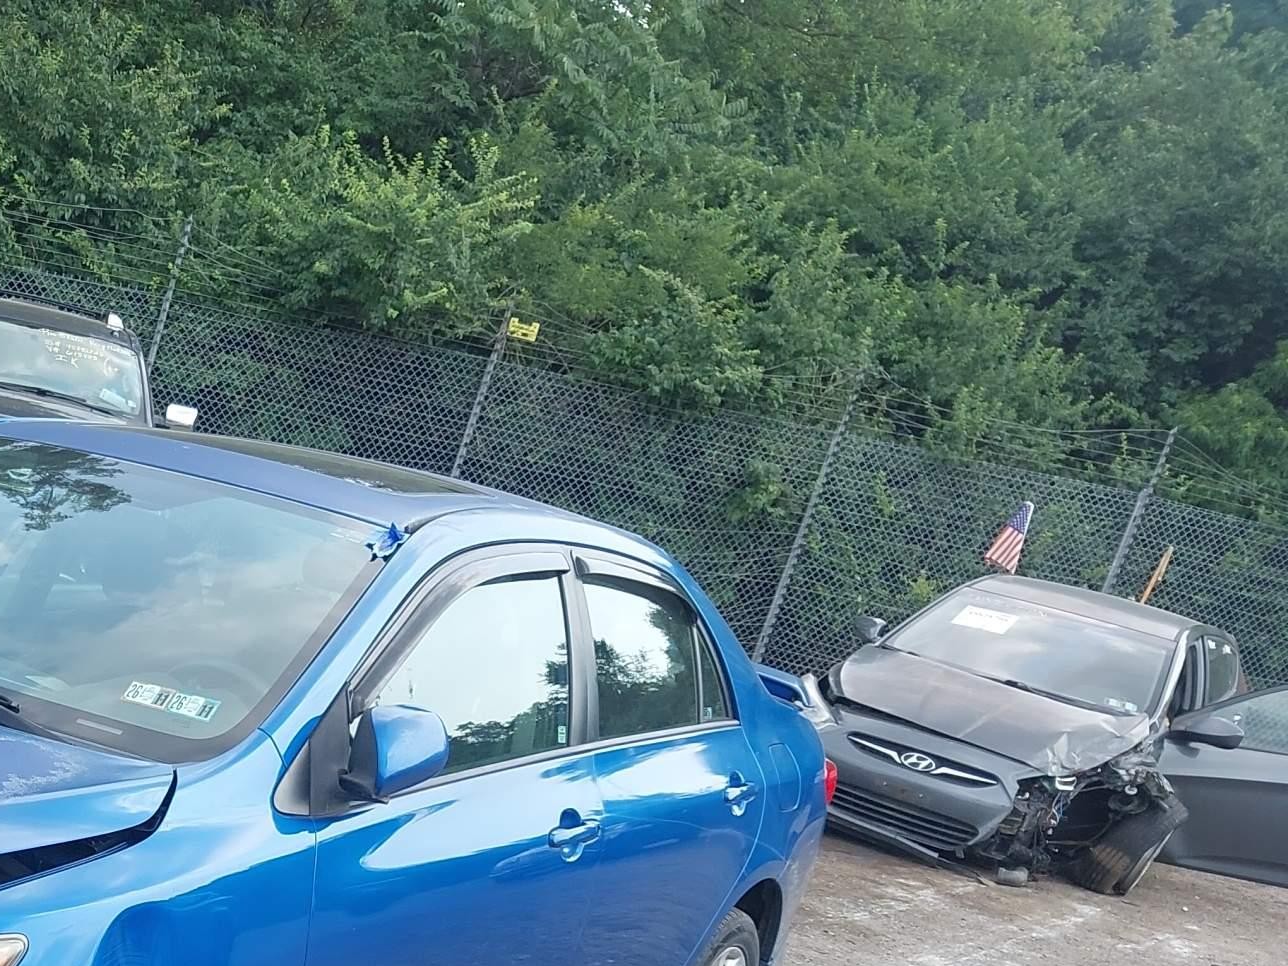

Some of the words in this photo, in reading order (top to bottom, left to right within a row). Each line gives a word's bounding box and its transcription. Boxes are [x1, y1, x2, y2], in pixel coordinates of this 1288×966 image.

[126, 683, 144, 699] 26
[152, 692, 170, 706] 11
[170, 695, 187, 711] 26
[198, 703, 214, 718] 11
